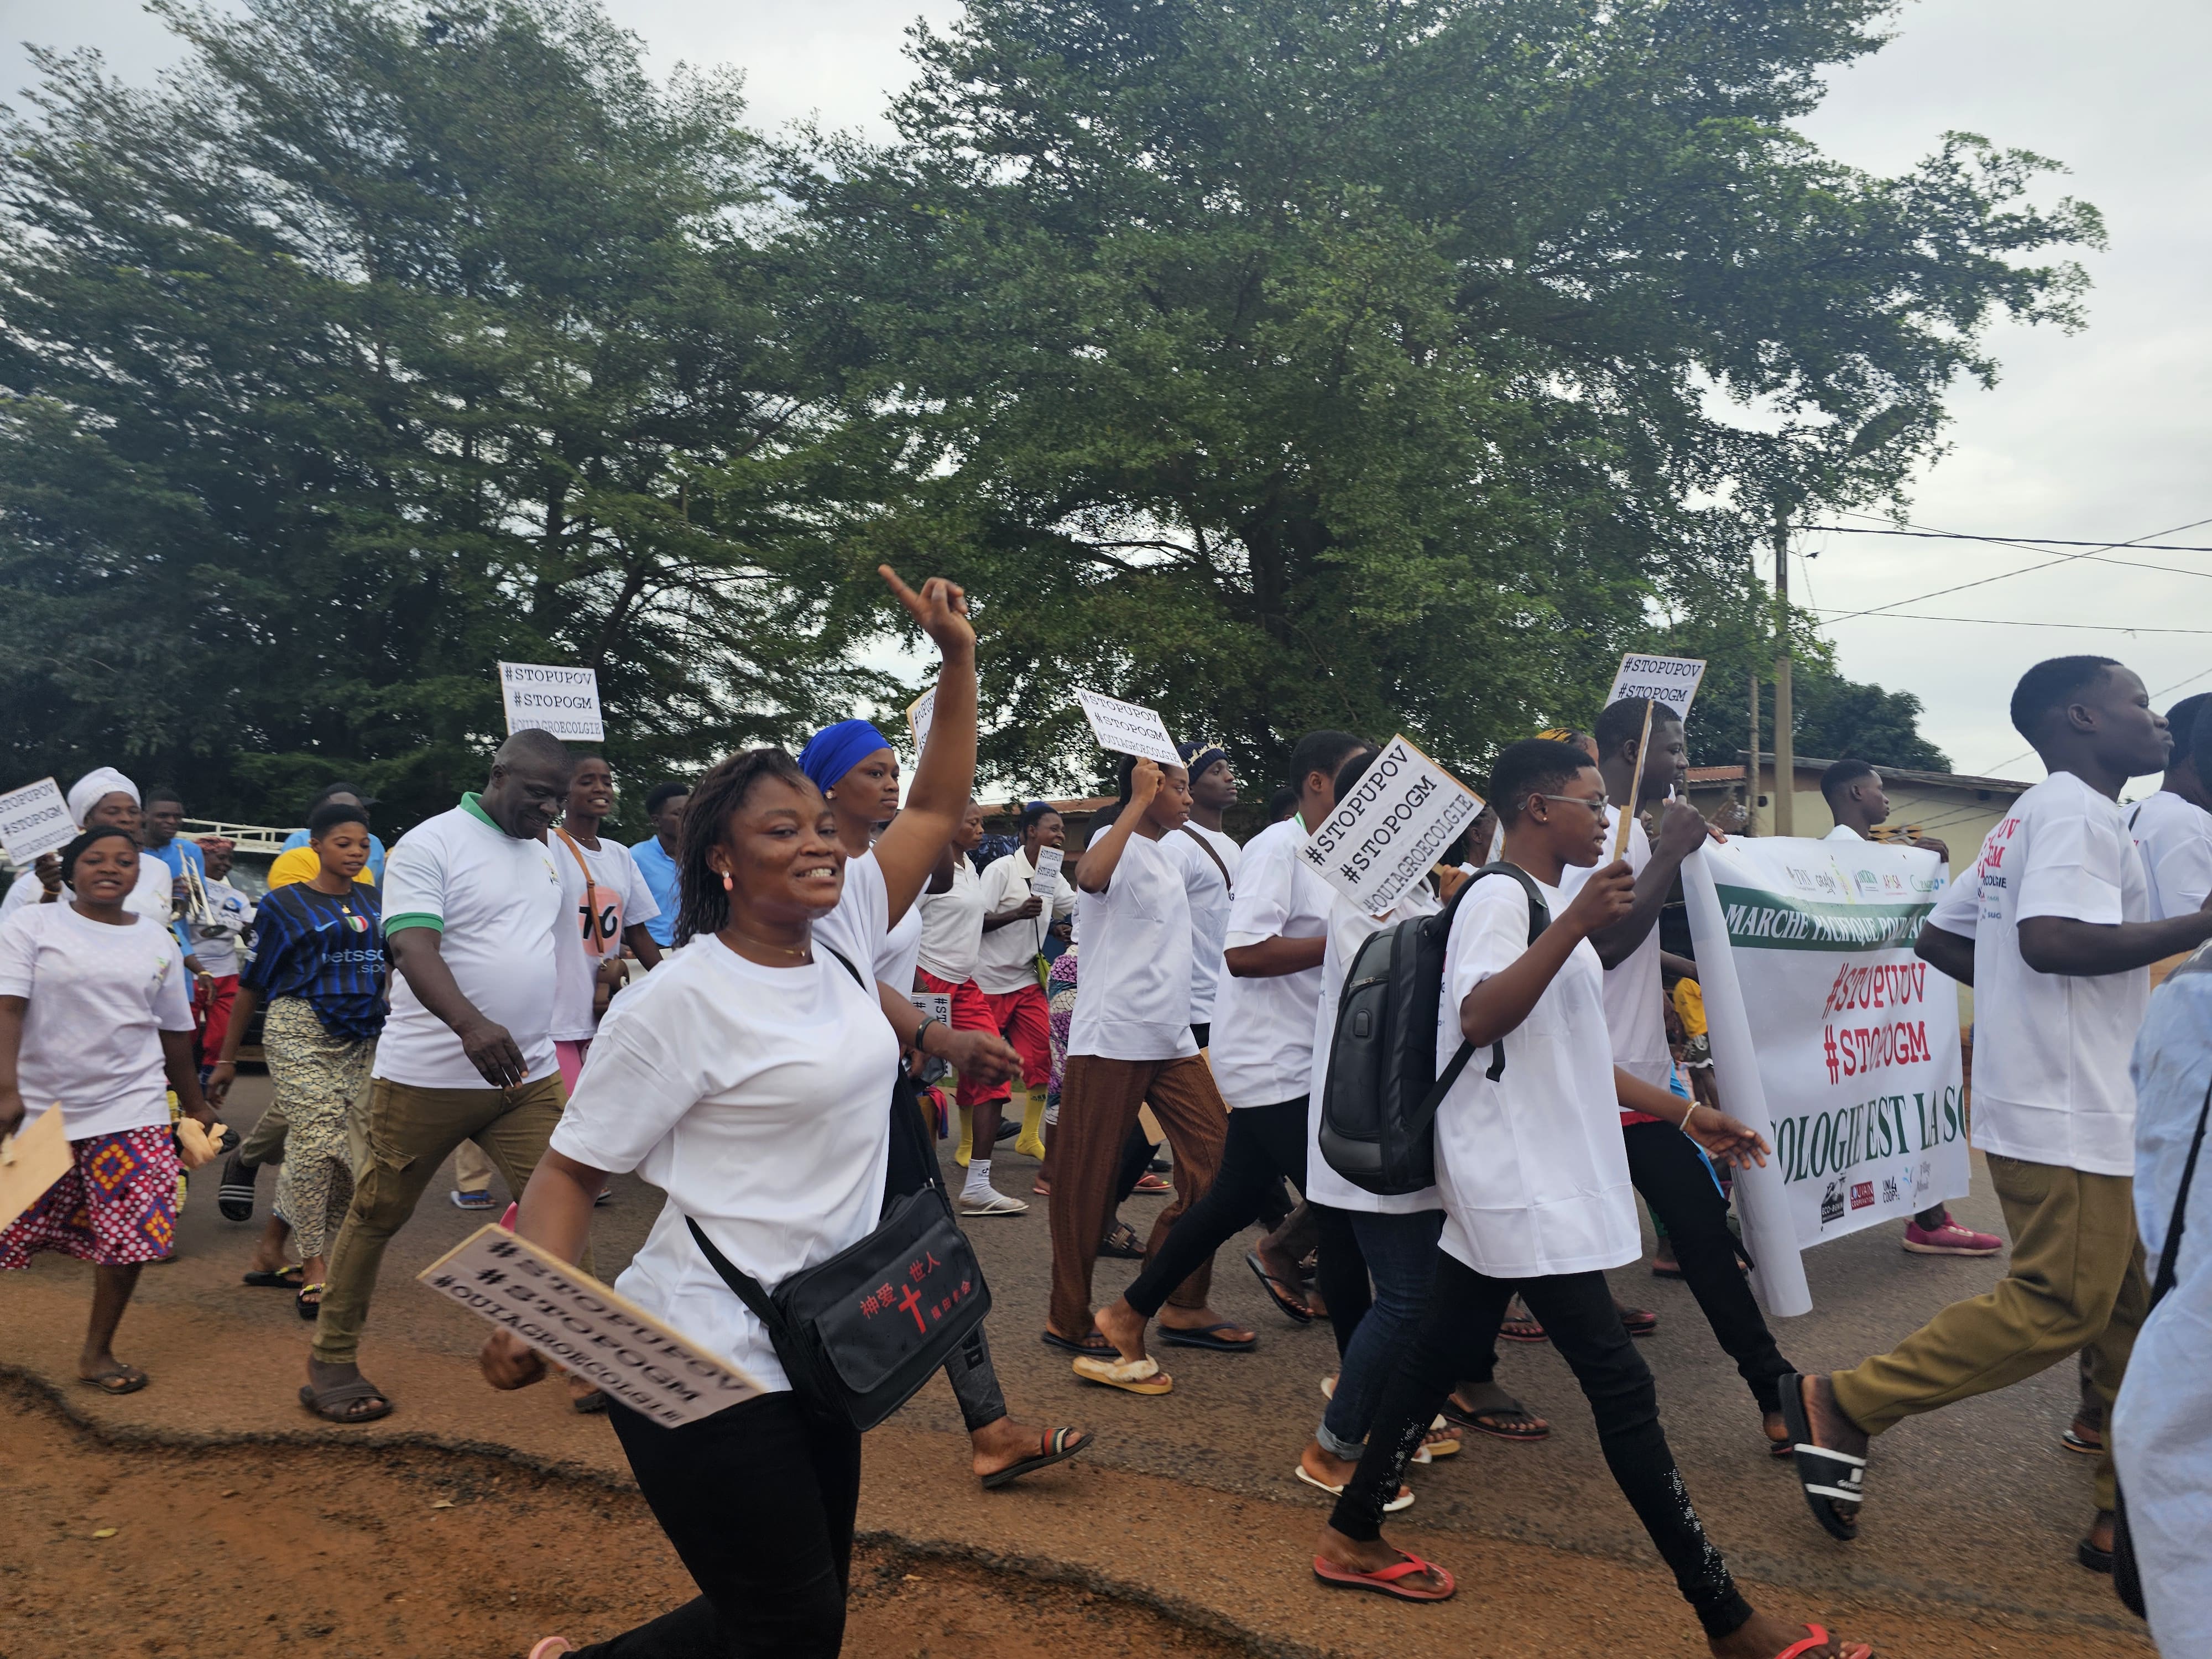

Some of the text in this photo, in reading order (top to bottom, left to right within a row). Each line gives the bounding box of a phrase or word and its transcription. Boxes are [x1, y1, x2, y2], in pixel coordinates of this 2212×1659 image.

[505, 665, 592, 685] #STOPUPOV
[1624, 657, 1702, 677] #STOPUPOV
[514, 691, 592, 709] #STOPOGM
[1081, 691, 1157, 723] #STOPUPOV
[1618, 682, 1688, 702] #STOPOGM
[1094, 712, 1166, 742] #STOPOGM
[1305, 745, 1408, 866] #STOPUPOV
[1340, 775, 1437, 884] #STOPOGM
[1363, 793, 1474, 913] #OUIAGROECOLGIE
[1725, 904, 1810, 940] MARCHE
[1811, 915, 1879, 947] PACIFIQUE
[1770, 1103, 1864, 1185] OLOGIE
[1865, 1094, 1910, 1161] EST
[1913, 1090, 1939, 1150] LA
[476, 1268, 700, 1402] #STOPOGM
[488, 1241, 747, 1391] #STOPUPOV
